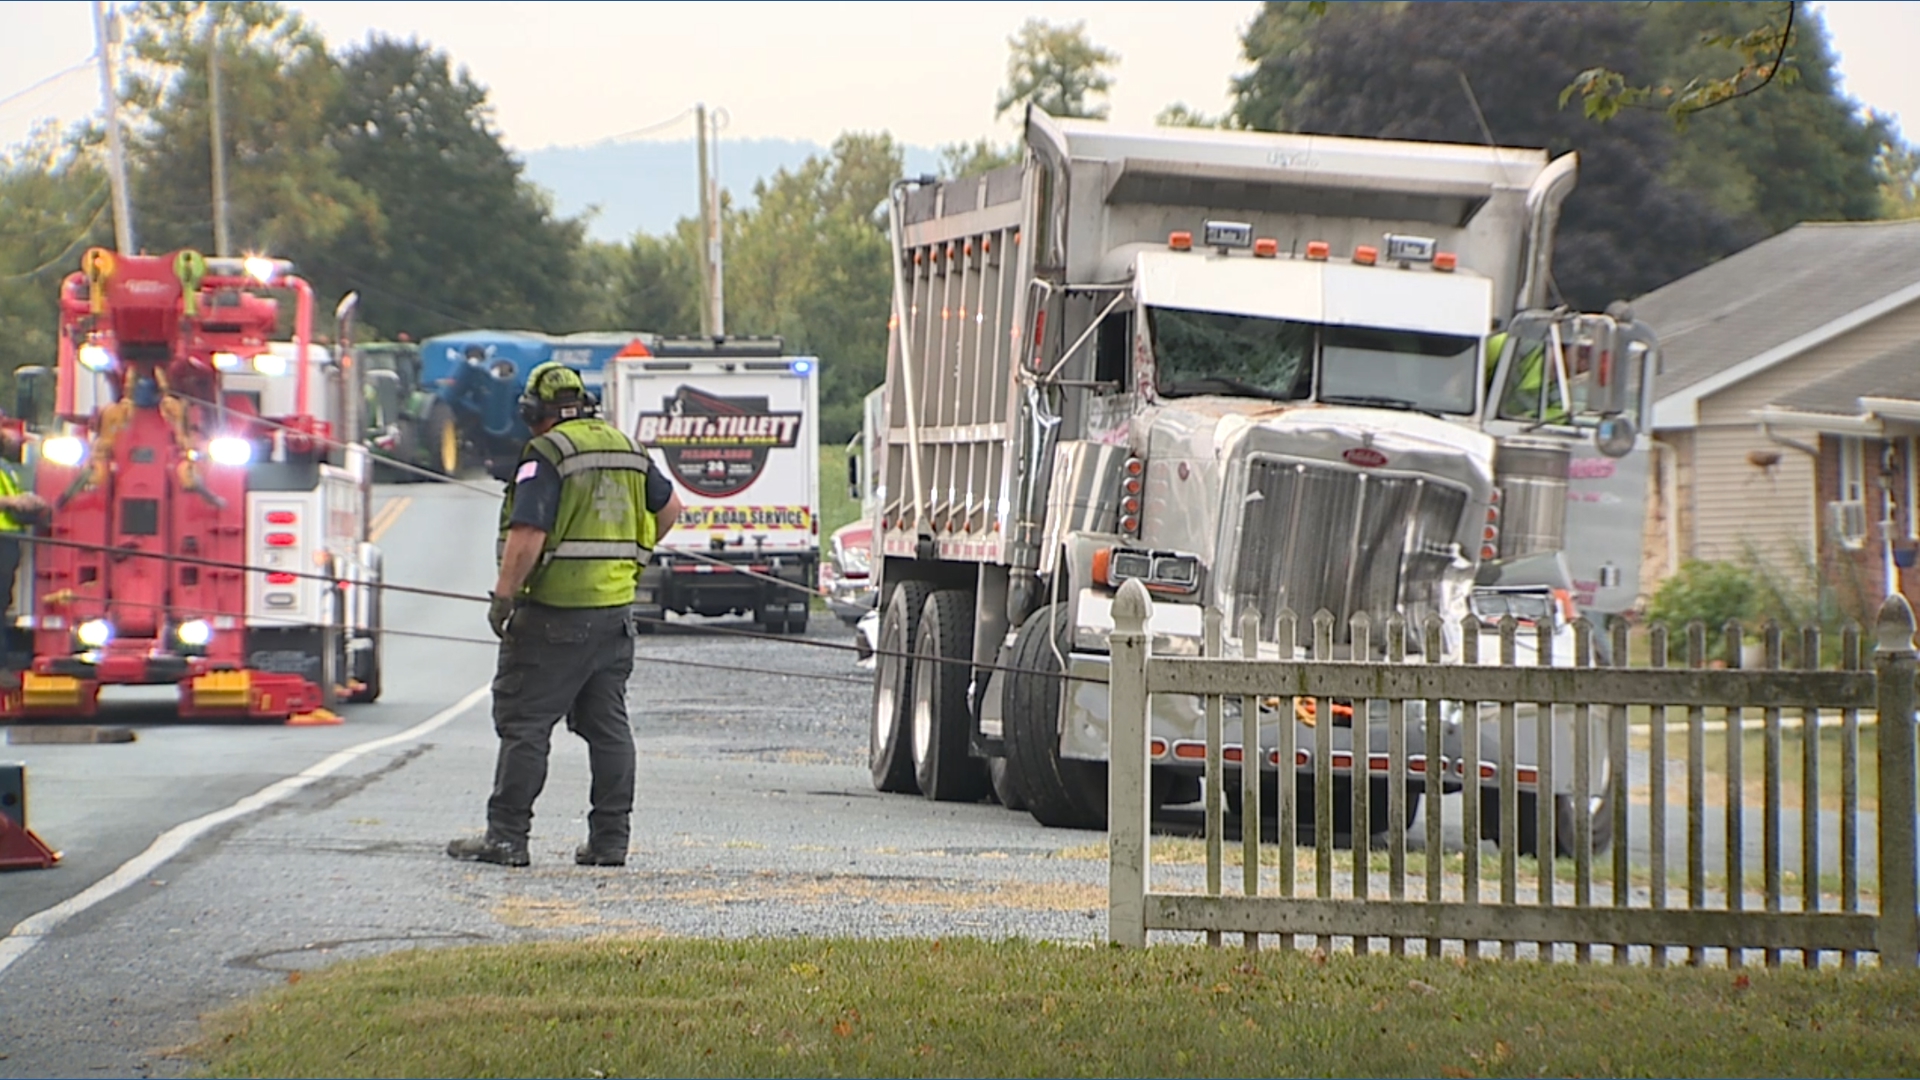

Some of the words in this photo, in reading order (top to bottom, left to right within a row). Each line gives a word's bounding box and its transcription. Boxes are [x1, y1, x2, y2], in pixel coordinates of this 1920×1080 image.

[637, 416, 708, 442] BLATT
[716, 416, 799, 442] TILLETT
[713, 510, 747, 524] ROAD
[751, 510, 803, 524] SERVICE
